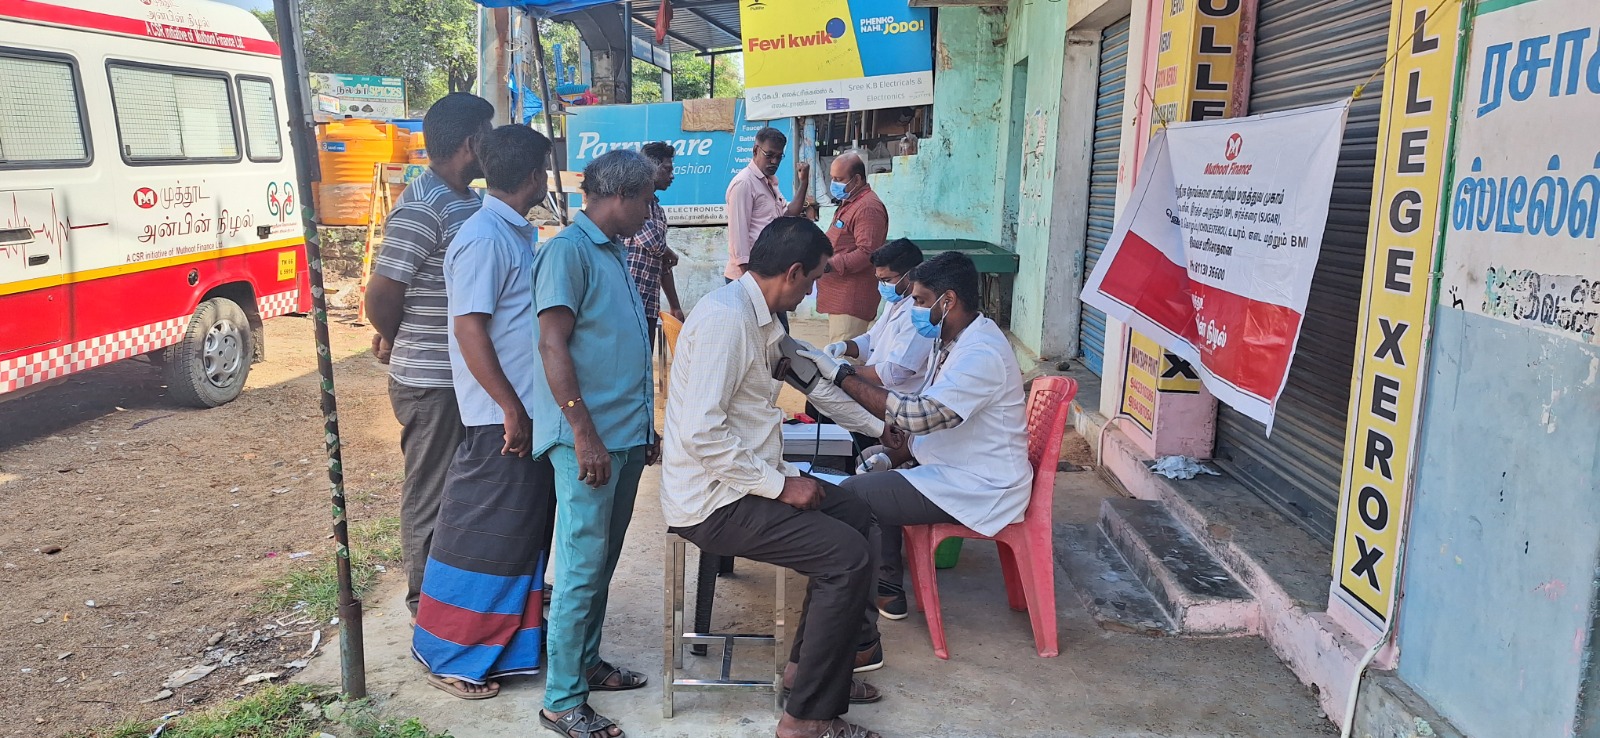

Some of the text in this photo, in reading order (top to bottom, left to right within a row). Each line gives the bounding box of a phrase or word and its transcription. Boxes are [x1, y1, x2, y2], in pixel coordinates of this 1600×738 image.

[150, 21, 166, 38] CSR
[860, 16, 894, 26] PHENKO
[860, 20, 924, 35] NAHI. JODO!
[748, 30, 833, 52] Fevi kwik
[866, 82, 878, 90] K.B
[880, 78, 916, 88] Electricals
[866, 92, 905, 102] Electronics
[1204, 162, 1252, 175] Muthoot Finance
[160, 179, 210, 209] முத்தூட்
[138, 212, 211, 244] அன்பின்
[216, 209, 254, 238] நிழல்
[1264, 230, 1287, 249] மற்றும்
[1290, 235, 1309, 248] BMI
[126, 254, 131, 262] A
[132, 251, 144, 262] CSR
[145, 248, 168, 259] initiative
[168, 247, 174, 257] of
[176, 244, 196, 255] Muthoot
[197, 242, 215, 253] Finance
[1351, 318, 1408, 592] XEROX
